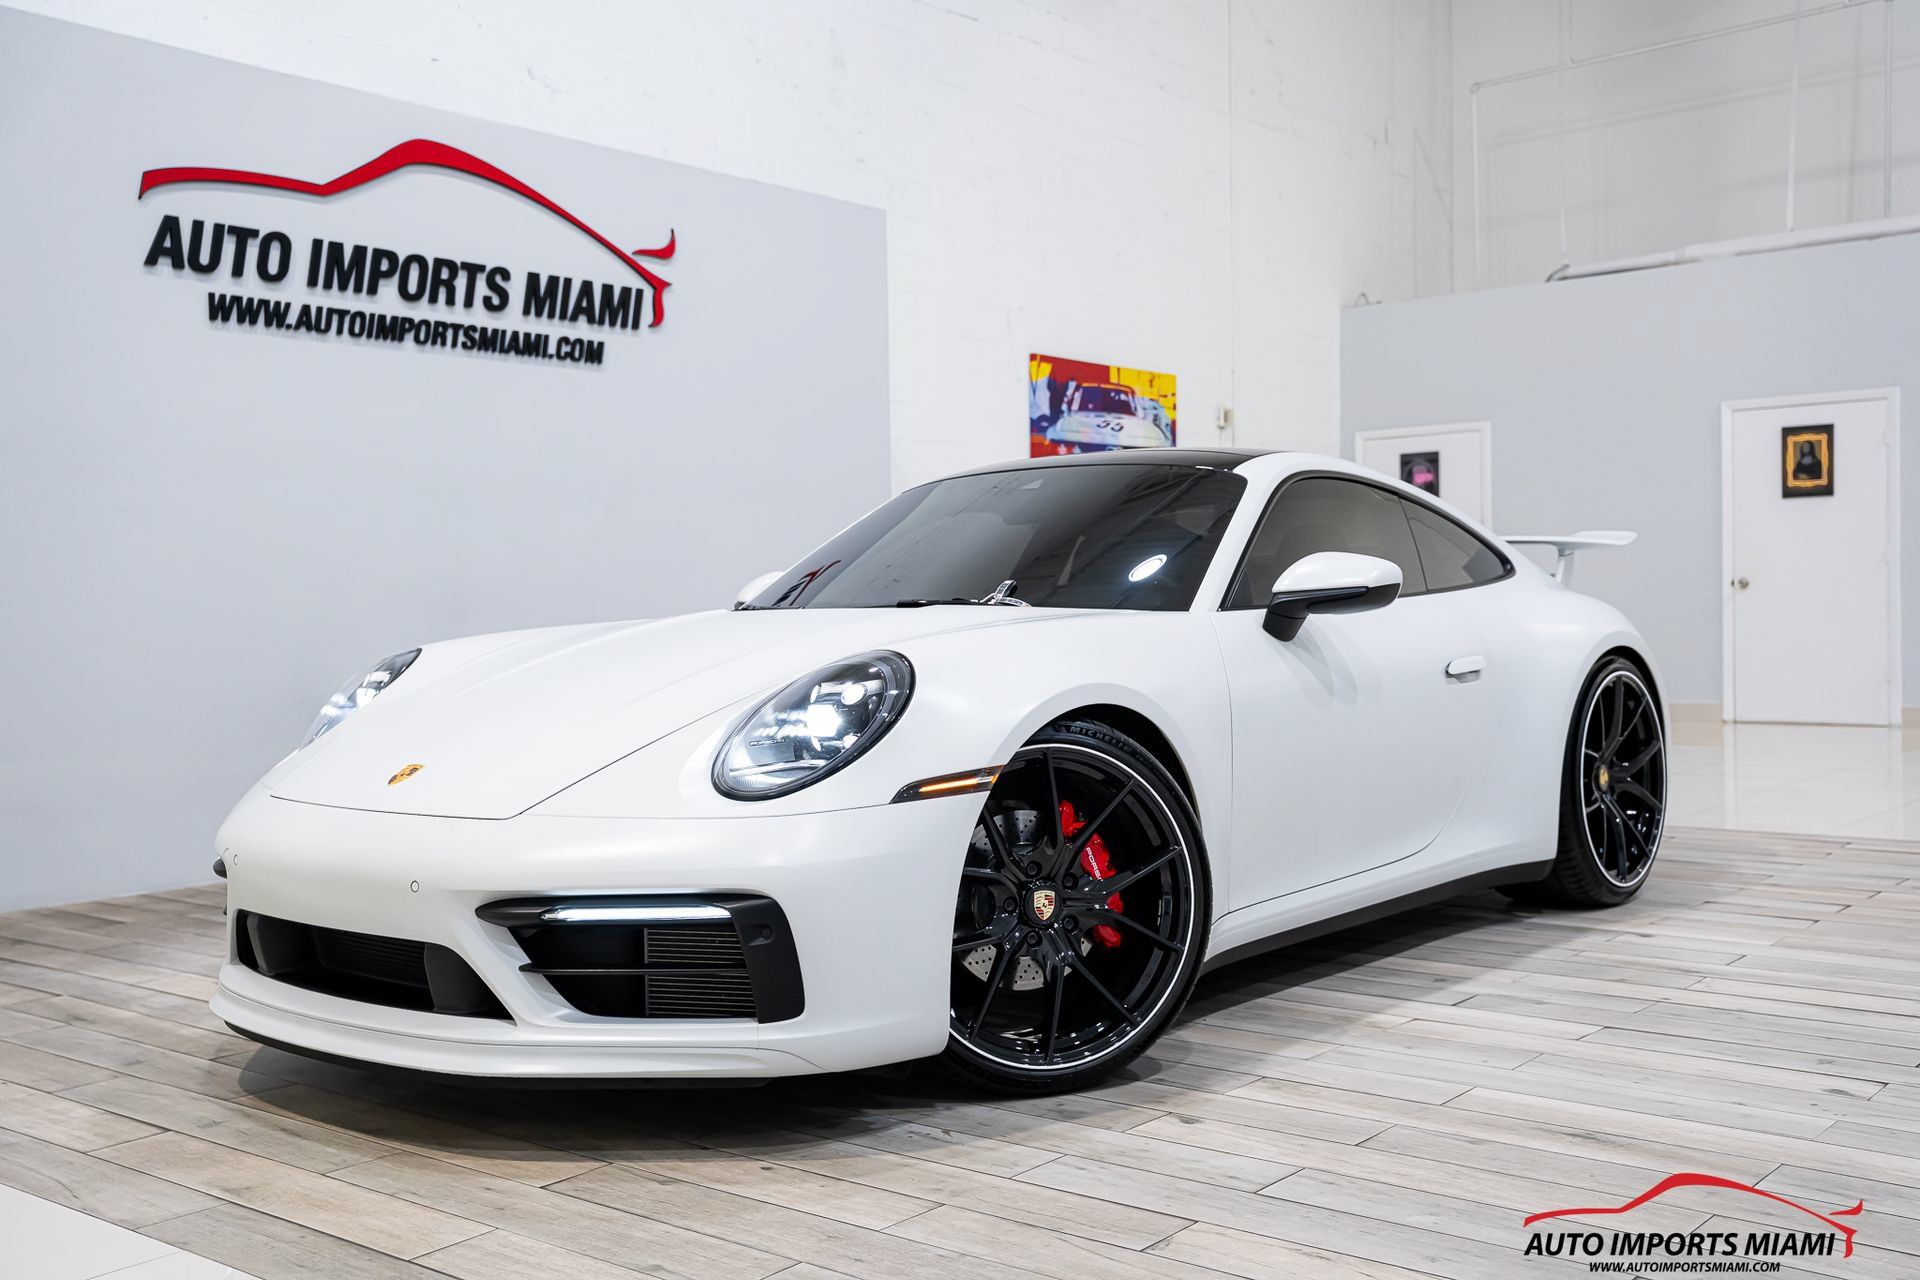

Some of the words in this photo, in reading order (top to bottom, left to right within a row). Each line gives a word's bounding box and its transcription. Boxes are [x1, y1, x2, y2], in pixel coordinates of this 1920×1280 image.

[144, 214, 292, 284] AUTO
[306, 238, 512, 313] IMPORTS
[522, 271, 645, 331] MIAMI
[207, 292, 605, 365] WWW.AUTOIMPORTSMIAMI.COM
